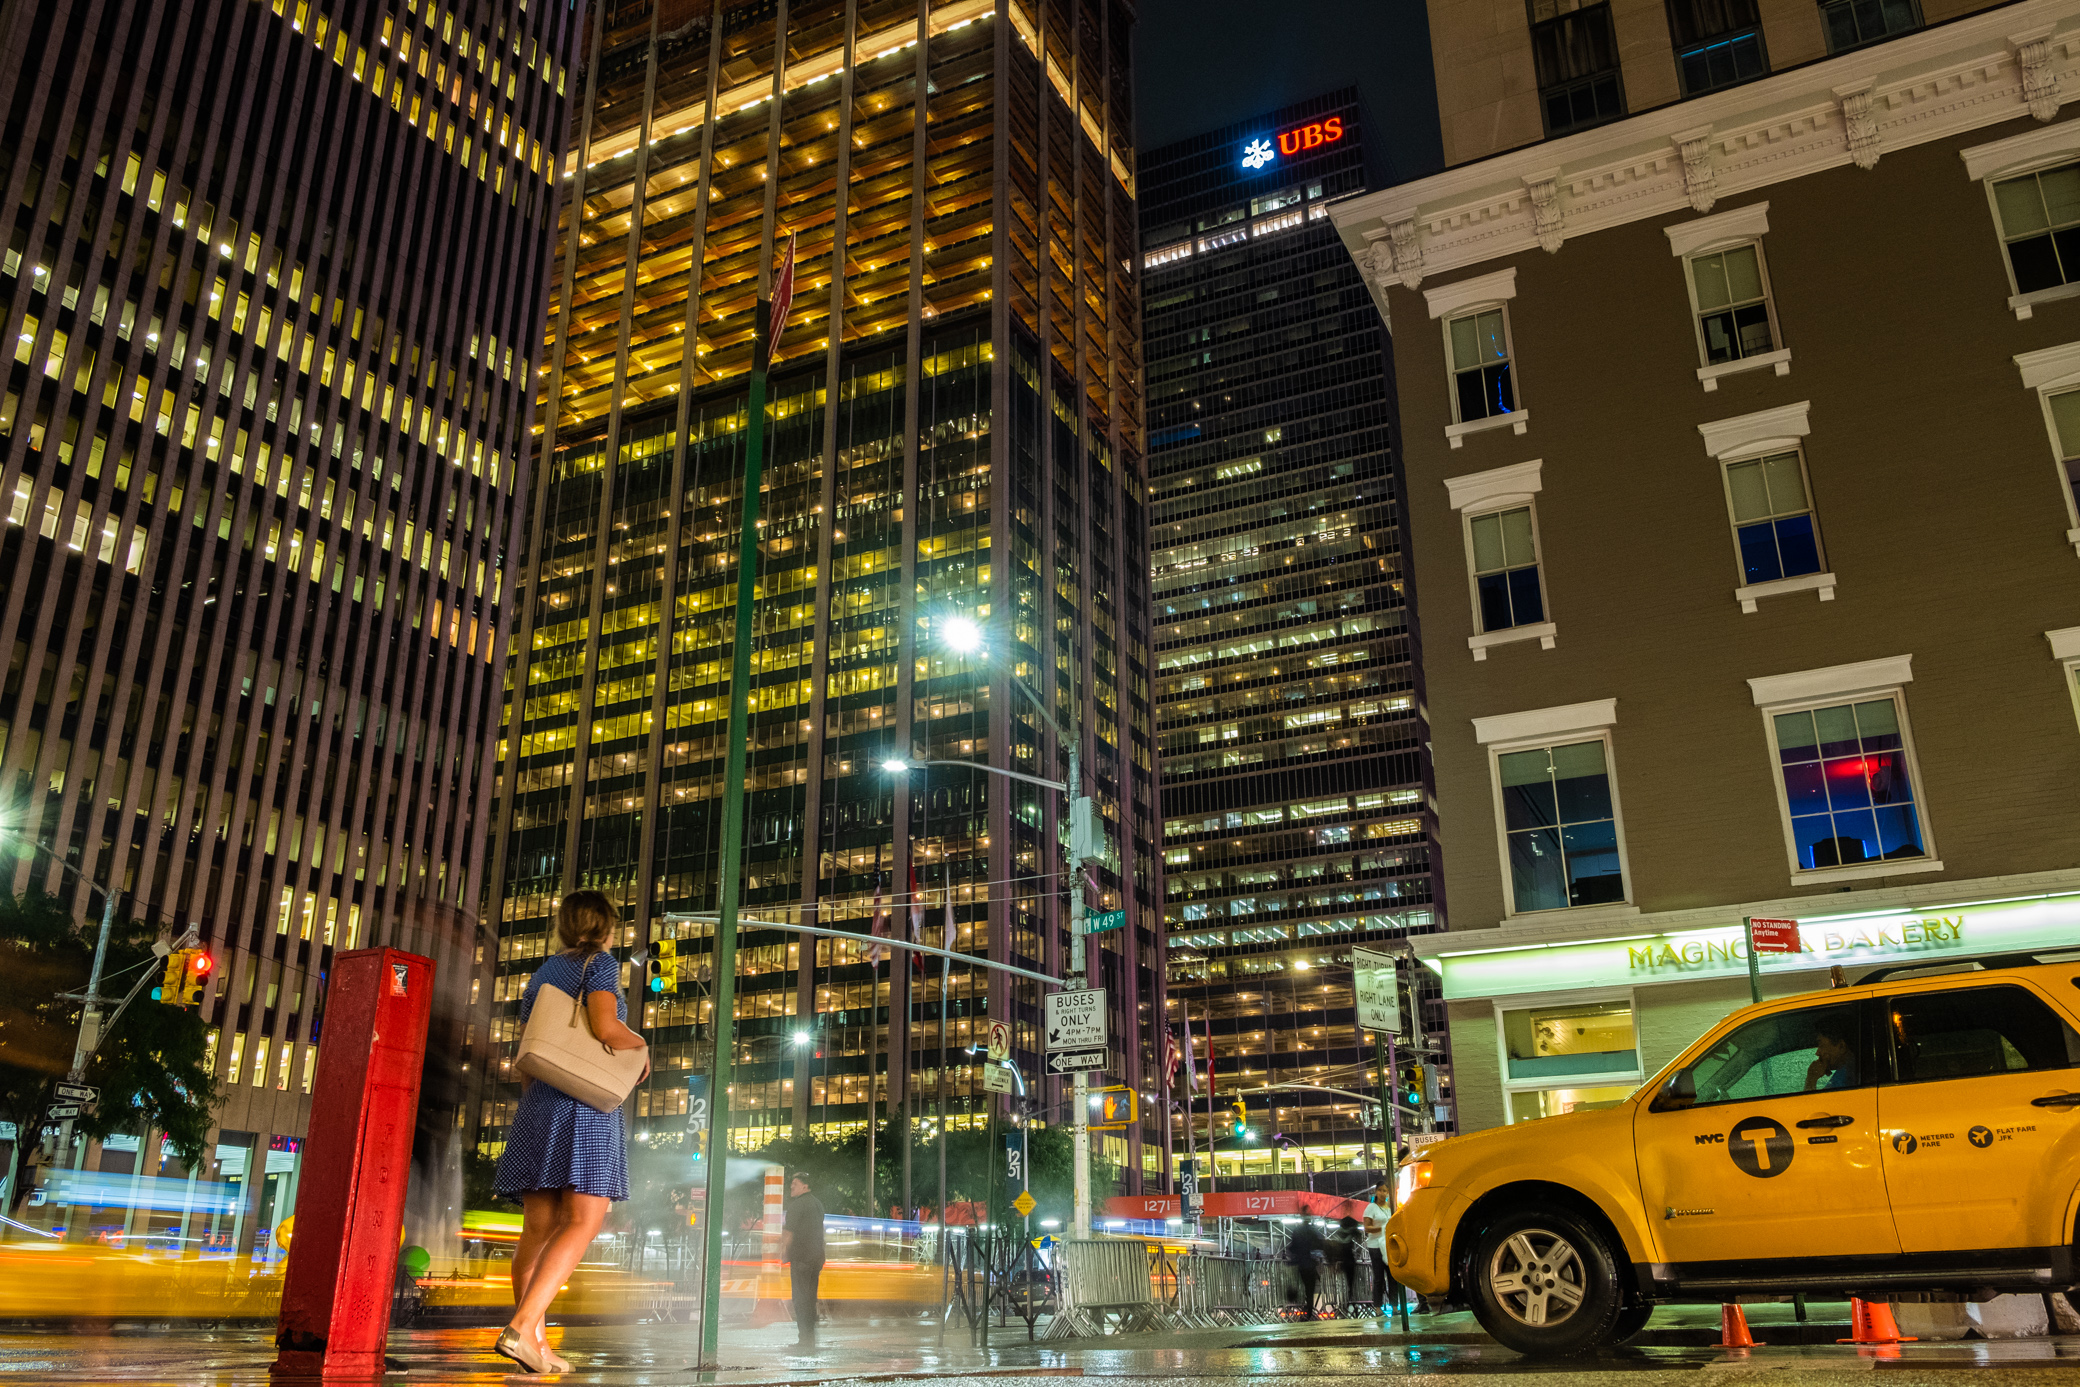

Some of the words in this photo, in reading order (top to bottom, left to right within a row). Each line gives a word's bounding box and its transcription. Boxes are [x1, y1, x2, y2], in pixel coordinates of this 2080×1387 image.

[1277, 117, 1343, 155] UBS
[1093, 917, 1100, 930] W
[1102, 914, 1115, 928] 49
[1116, 911, 1124, 920] ST
[1762, 922, 1792, 930] STANDING
[1753, 929, 1779, 937] Anytime
[1628, 935, 1814, 968] MAGNOA
[1824, 915, 1963, 951] BAKERY
[1356, 957, 1371, 970] RIGHT
[1056, 993, 1095, 1008] BUSES
[1360, 990, 1376, 1005] RIGHT
[1378, 993, 1396, 1008] LANE
[1060, 1013, 1091, 1027] ONLY
[1371, 1008, 1386, 1023] ONLY
[1062, 1038, 1077, 1046] MON
[1093, 1034, 1104, 1042] FRI
[1055, 1057, 1073, 1067] ONE
[1080, 1054, 1099, 1065] WAY
[61, 1088, 75, 1096] ONE
[79, 1091, 92, 1099] WAY
[688, 1094, 707, 1118] 12
[1920, 1132, 1955, 1141] METERED
[1996, 1127, 2015, 1135] FLAT
[2016, 1125, 2037, 1133] FARE
[1414, 1135, 1439, 1144] BUSES
[1921, 1140, 1941, 1148] FARE
[1998, 1134, 2013, 1142] JFK
[1694, 1133, 1725, 1145] NYC
[1740, 1127, 1777, 1170] T
[1006, 1147, 1020, 1166] 12
[1007, 1163, 1020, 1180] 51
[1180, 1171, 1192, 1186] 12
[1181, 1184, 1193, 1195] 51
[1144, 1200, 1170, 1213] 1271
[1246, 1196, 1275, 1211] 1271
